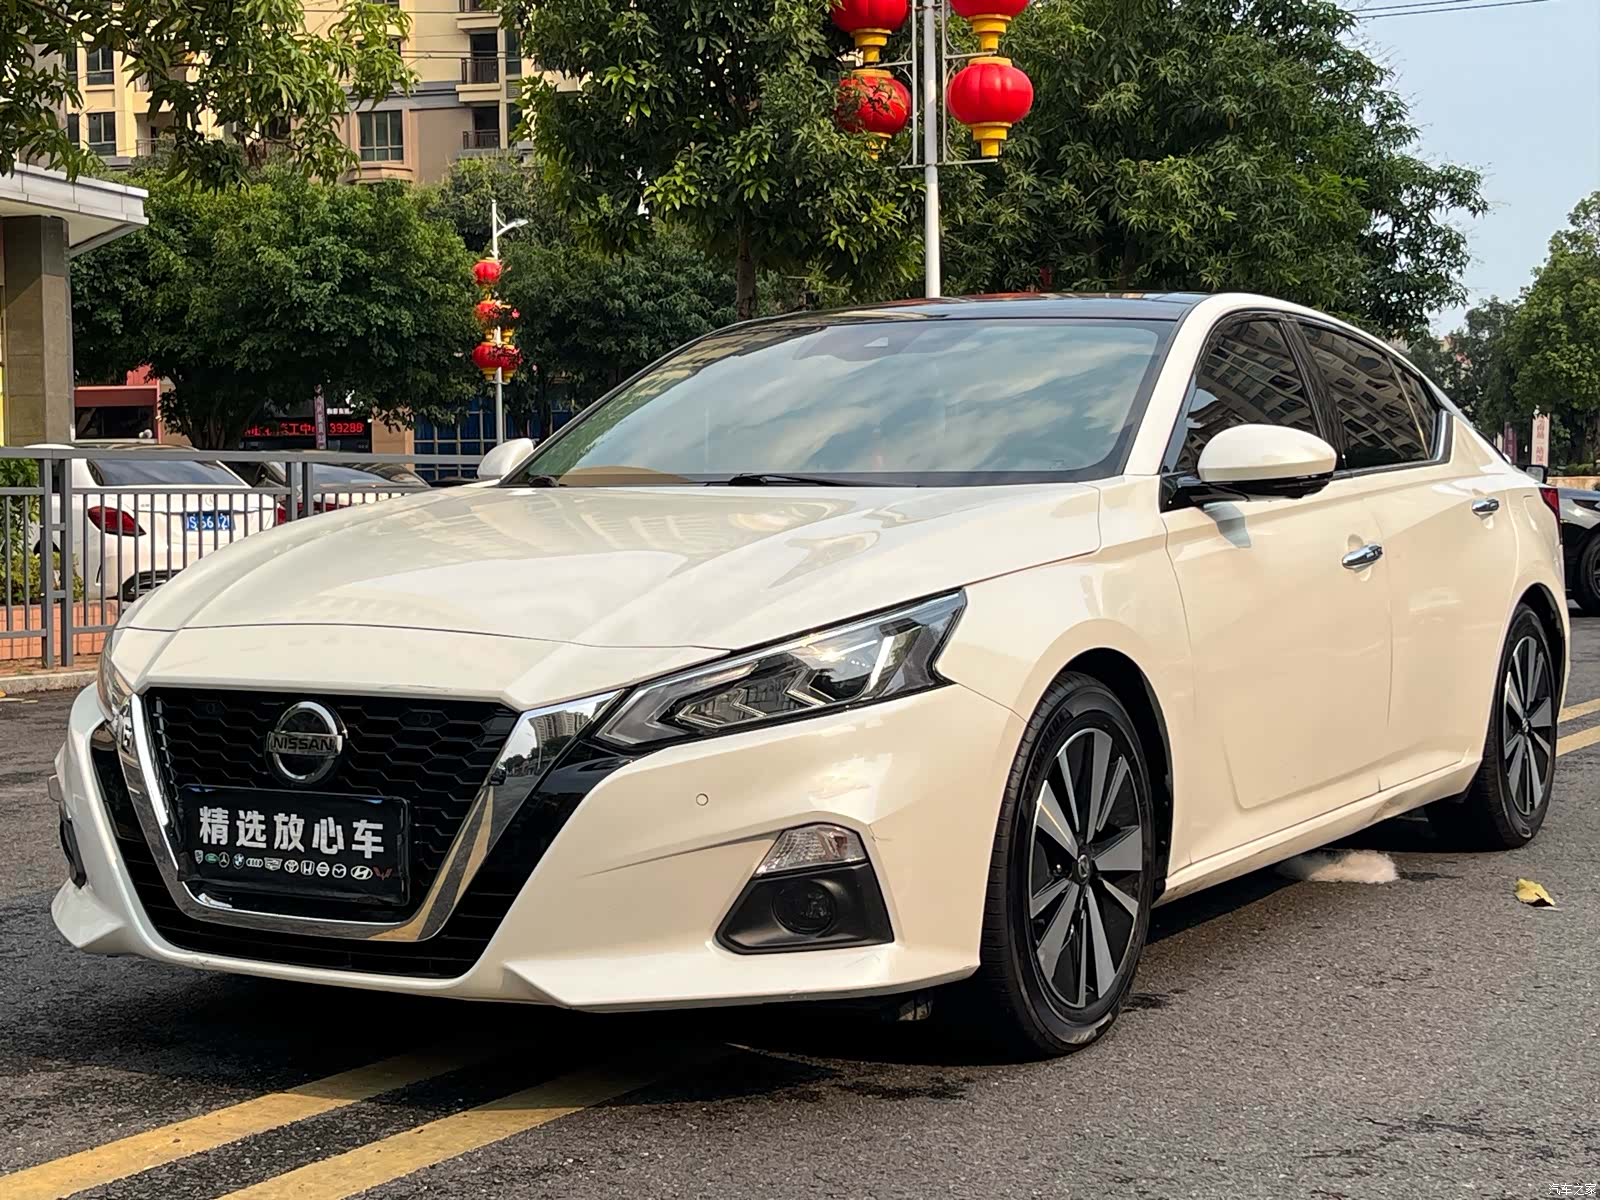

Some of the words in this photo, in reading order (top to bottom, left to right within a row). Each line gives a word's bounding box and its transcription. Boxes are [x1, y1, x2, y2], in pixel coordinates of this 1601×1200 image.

[273, 736, 332, 751] NISSAN
[199, 805, 385, 859] 精选放心车
